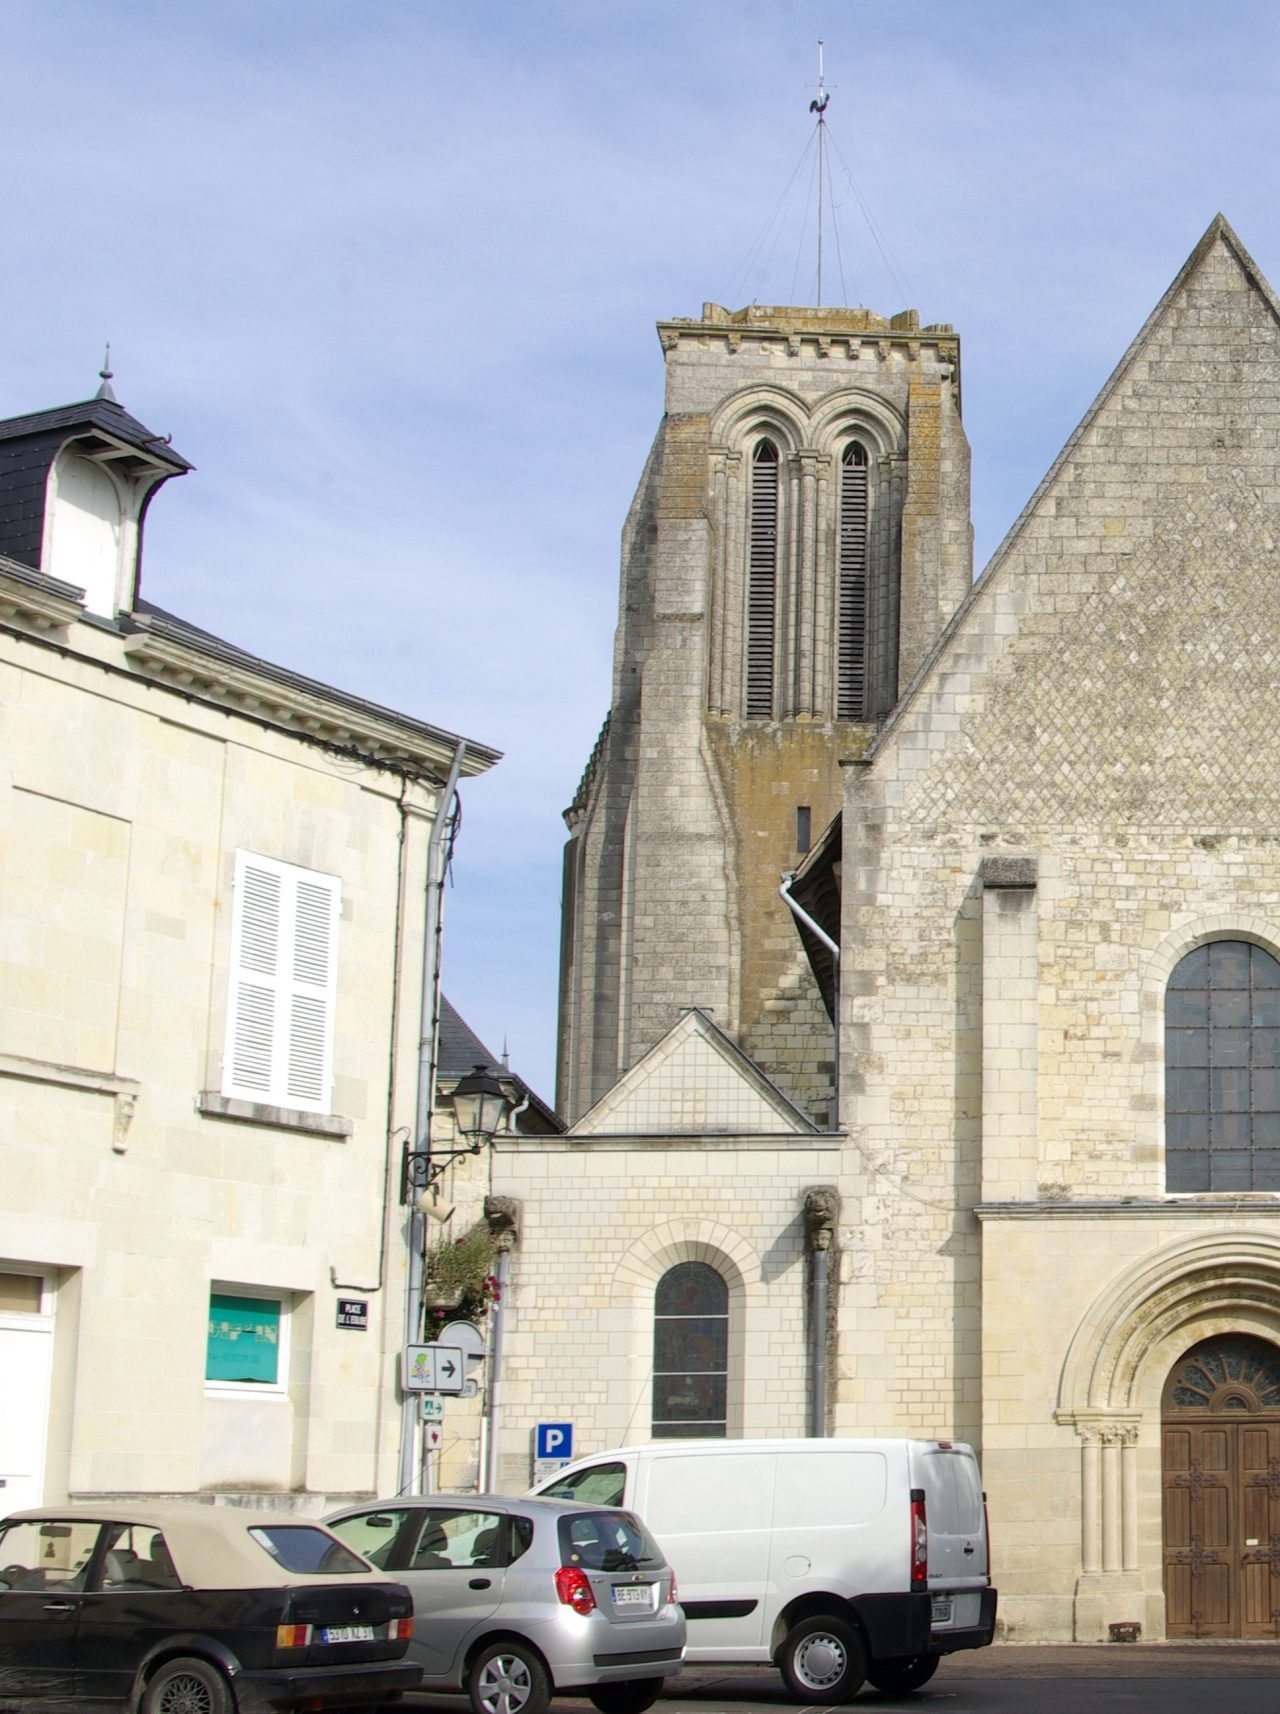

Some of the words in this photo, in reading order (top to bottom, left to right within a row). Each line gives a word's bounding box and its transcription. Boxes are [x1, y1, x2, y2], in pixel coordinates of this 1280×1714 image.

[345, 1303, 362, 1314] PLACE
[337, 1314, 346, 1324] DE
[545, 1429, 564, 1453] P
